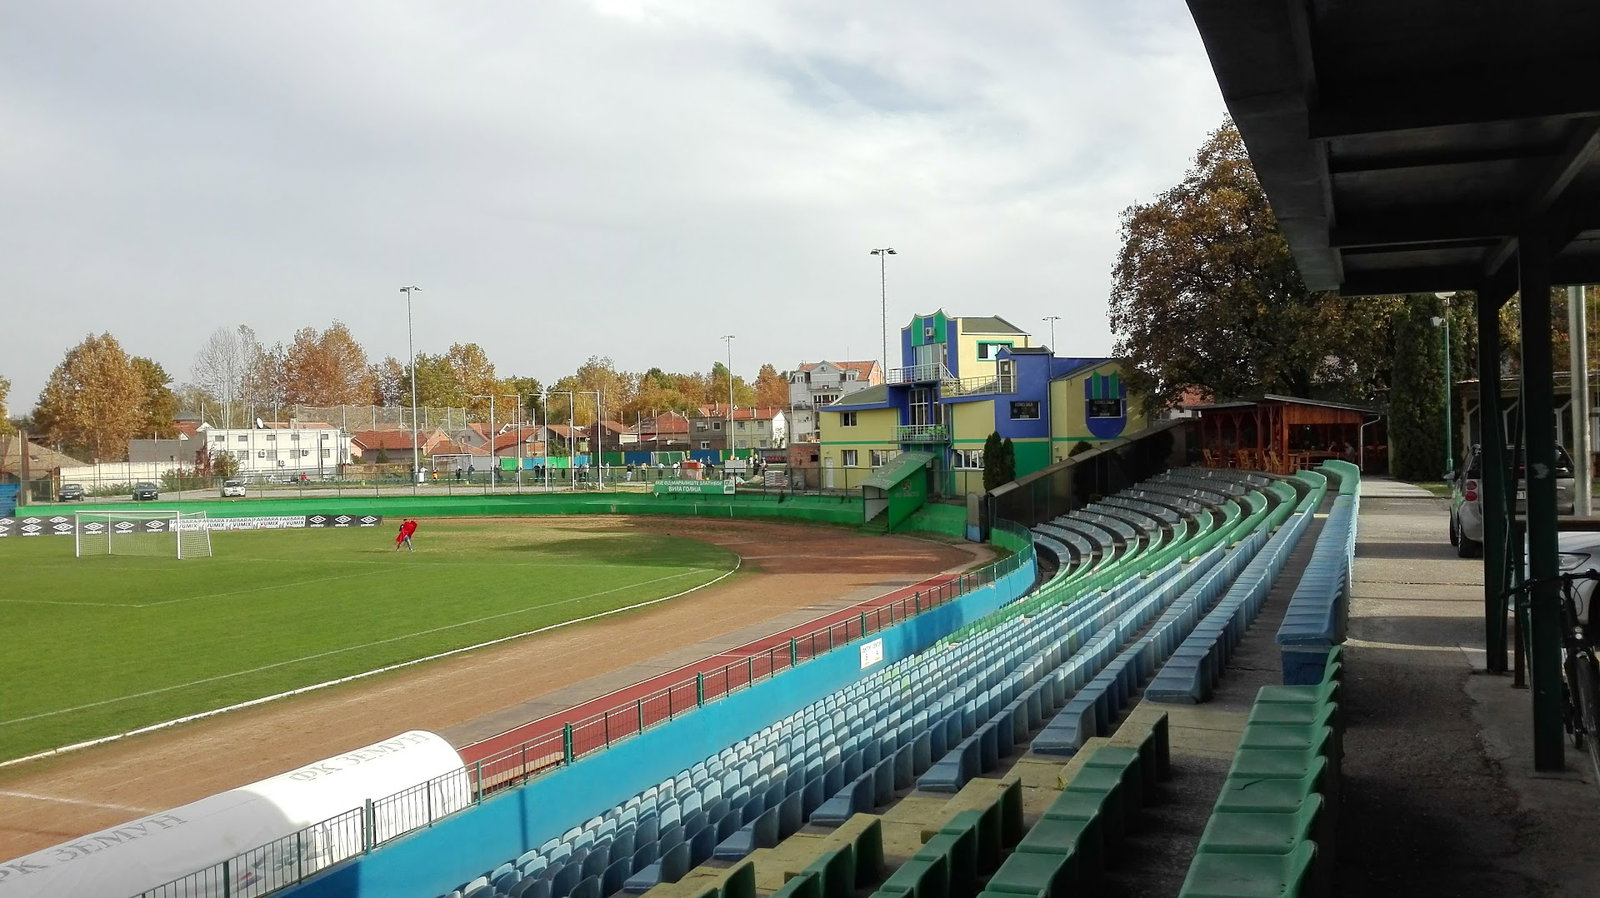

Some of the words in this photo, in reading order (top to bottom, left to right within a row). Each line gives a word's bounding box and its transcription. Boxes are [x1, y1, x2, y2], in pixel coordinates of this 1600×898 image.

[289, 762, 343, 782] ФК
[336, 732, 431, 766] ЗЕМУН
[49, 813, 189, 863] ЗЕМУН
